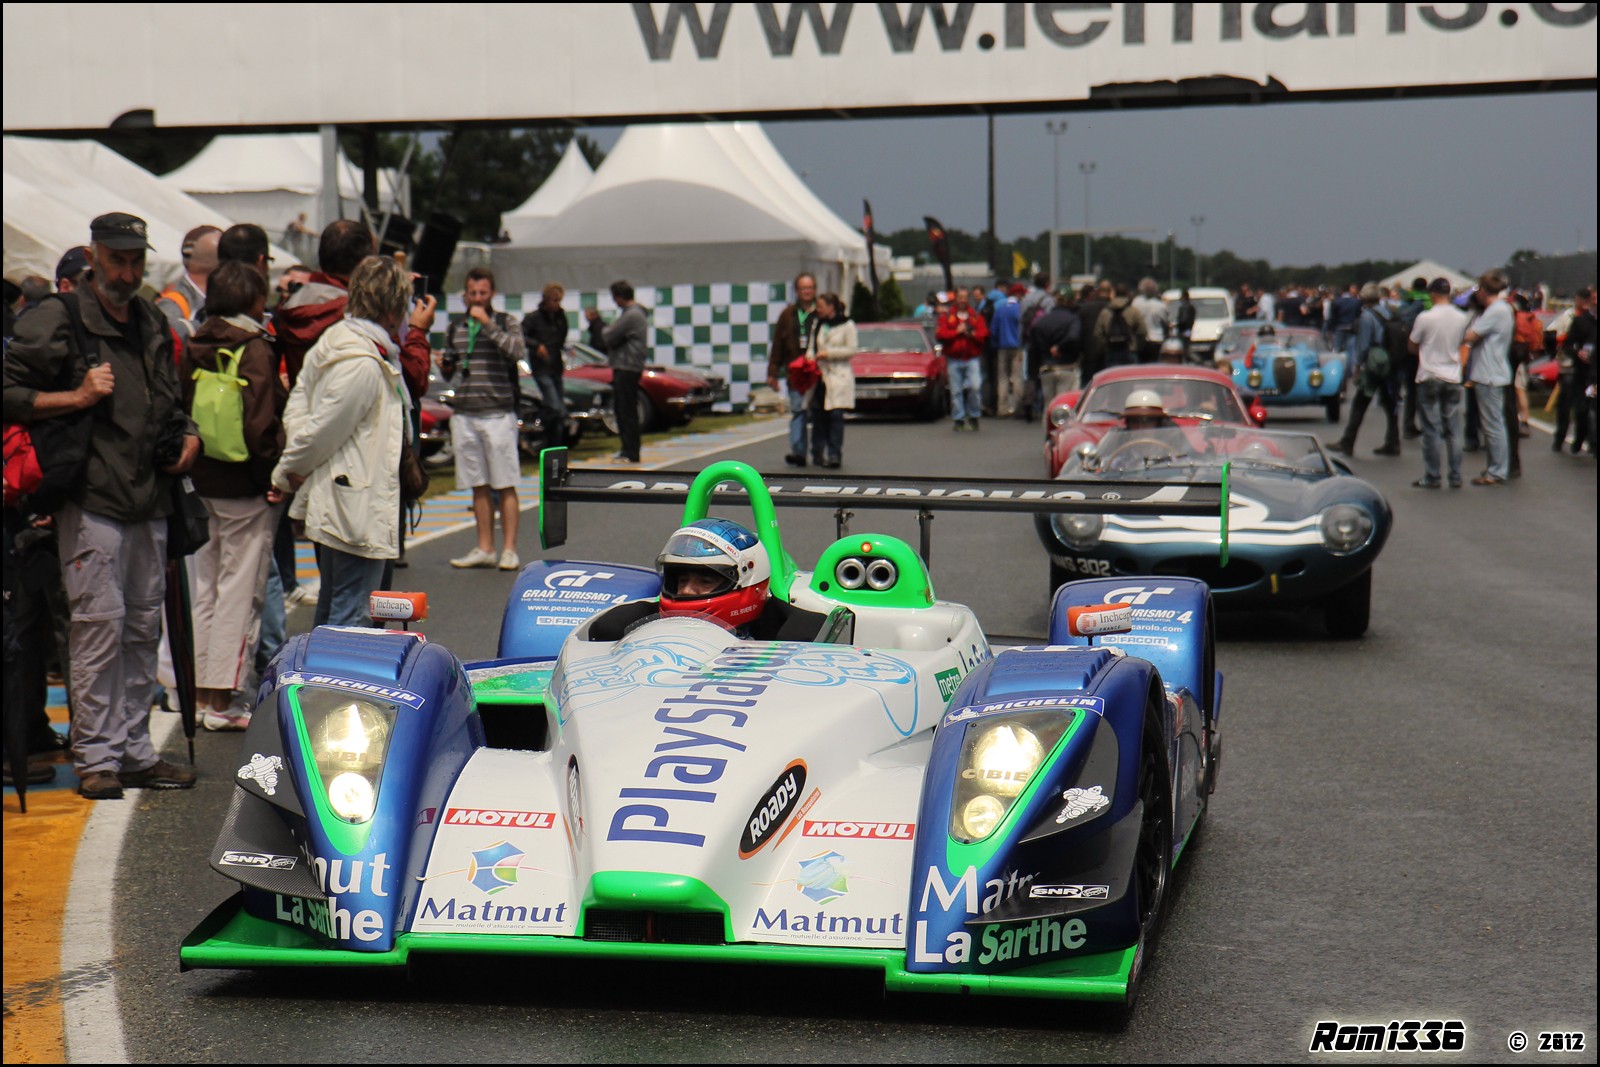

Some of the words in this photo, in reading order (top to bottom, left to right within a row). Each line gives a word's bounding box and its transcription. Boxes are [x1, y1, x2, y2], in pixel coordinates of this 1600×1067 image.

[1077, 558, 1111, 577] 302
[522, 589, 557, 598] GRAN
[559, 590, 612, 601] TURISMO
[611, 594, 628, 604] 4
[376, 599, 410, 613] Inchcape
[527, 605, 602, 613] www.pescarolo.c
[1099, 611, 1132, 624] Inchcap
[1130, 608, 1176, 619] RISMO
[1176, 611, 1193, 625] 4
[1131, 624, 1183, 633] carolo.com
[1120, 636, 1167, 645] FACOM
[309, 676, 417, 701] MICHELIN
[982, 698, 1098, 712] MICHELIN
[448, 809, 550, 828] MOTUL
[805, 822, 912, 838] MOTUL
[223, 853, 269, 865] SNR
[1032, 888, 1080, 896] SNR
[420, 897, 568, 923] Matmut
[752, 907, 904, 935] Matmut
[914, 920, 972, 964] La
[978, 917, 1088, 965] Sarthe
